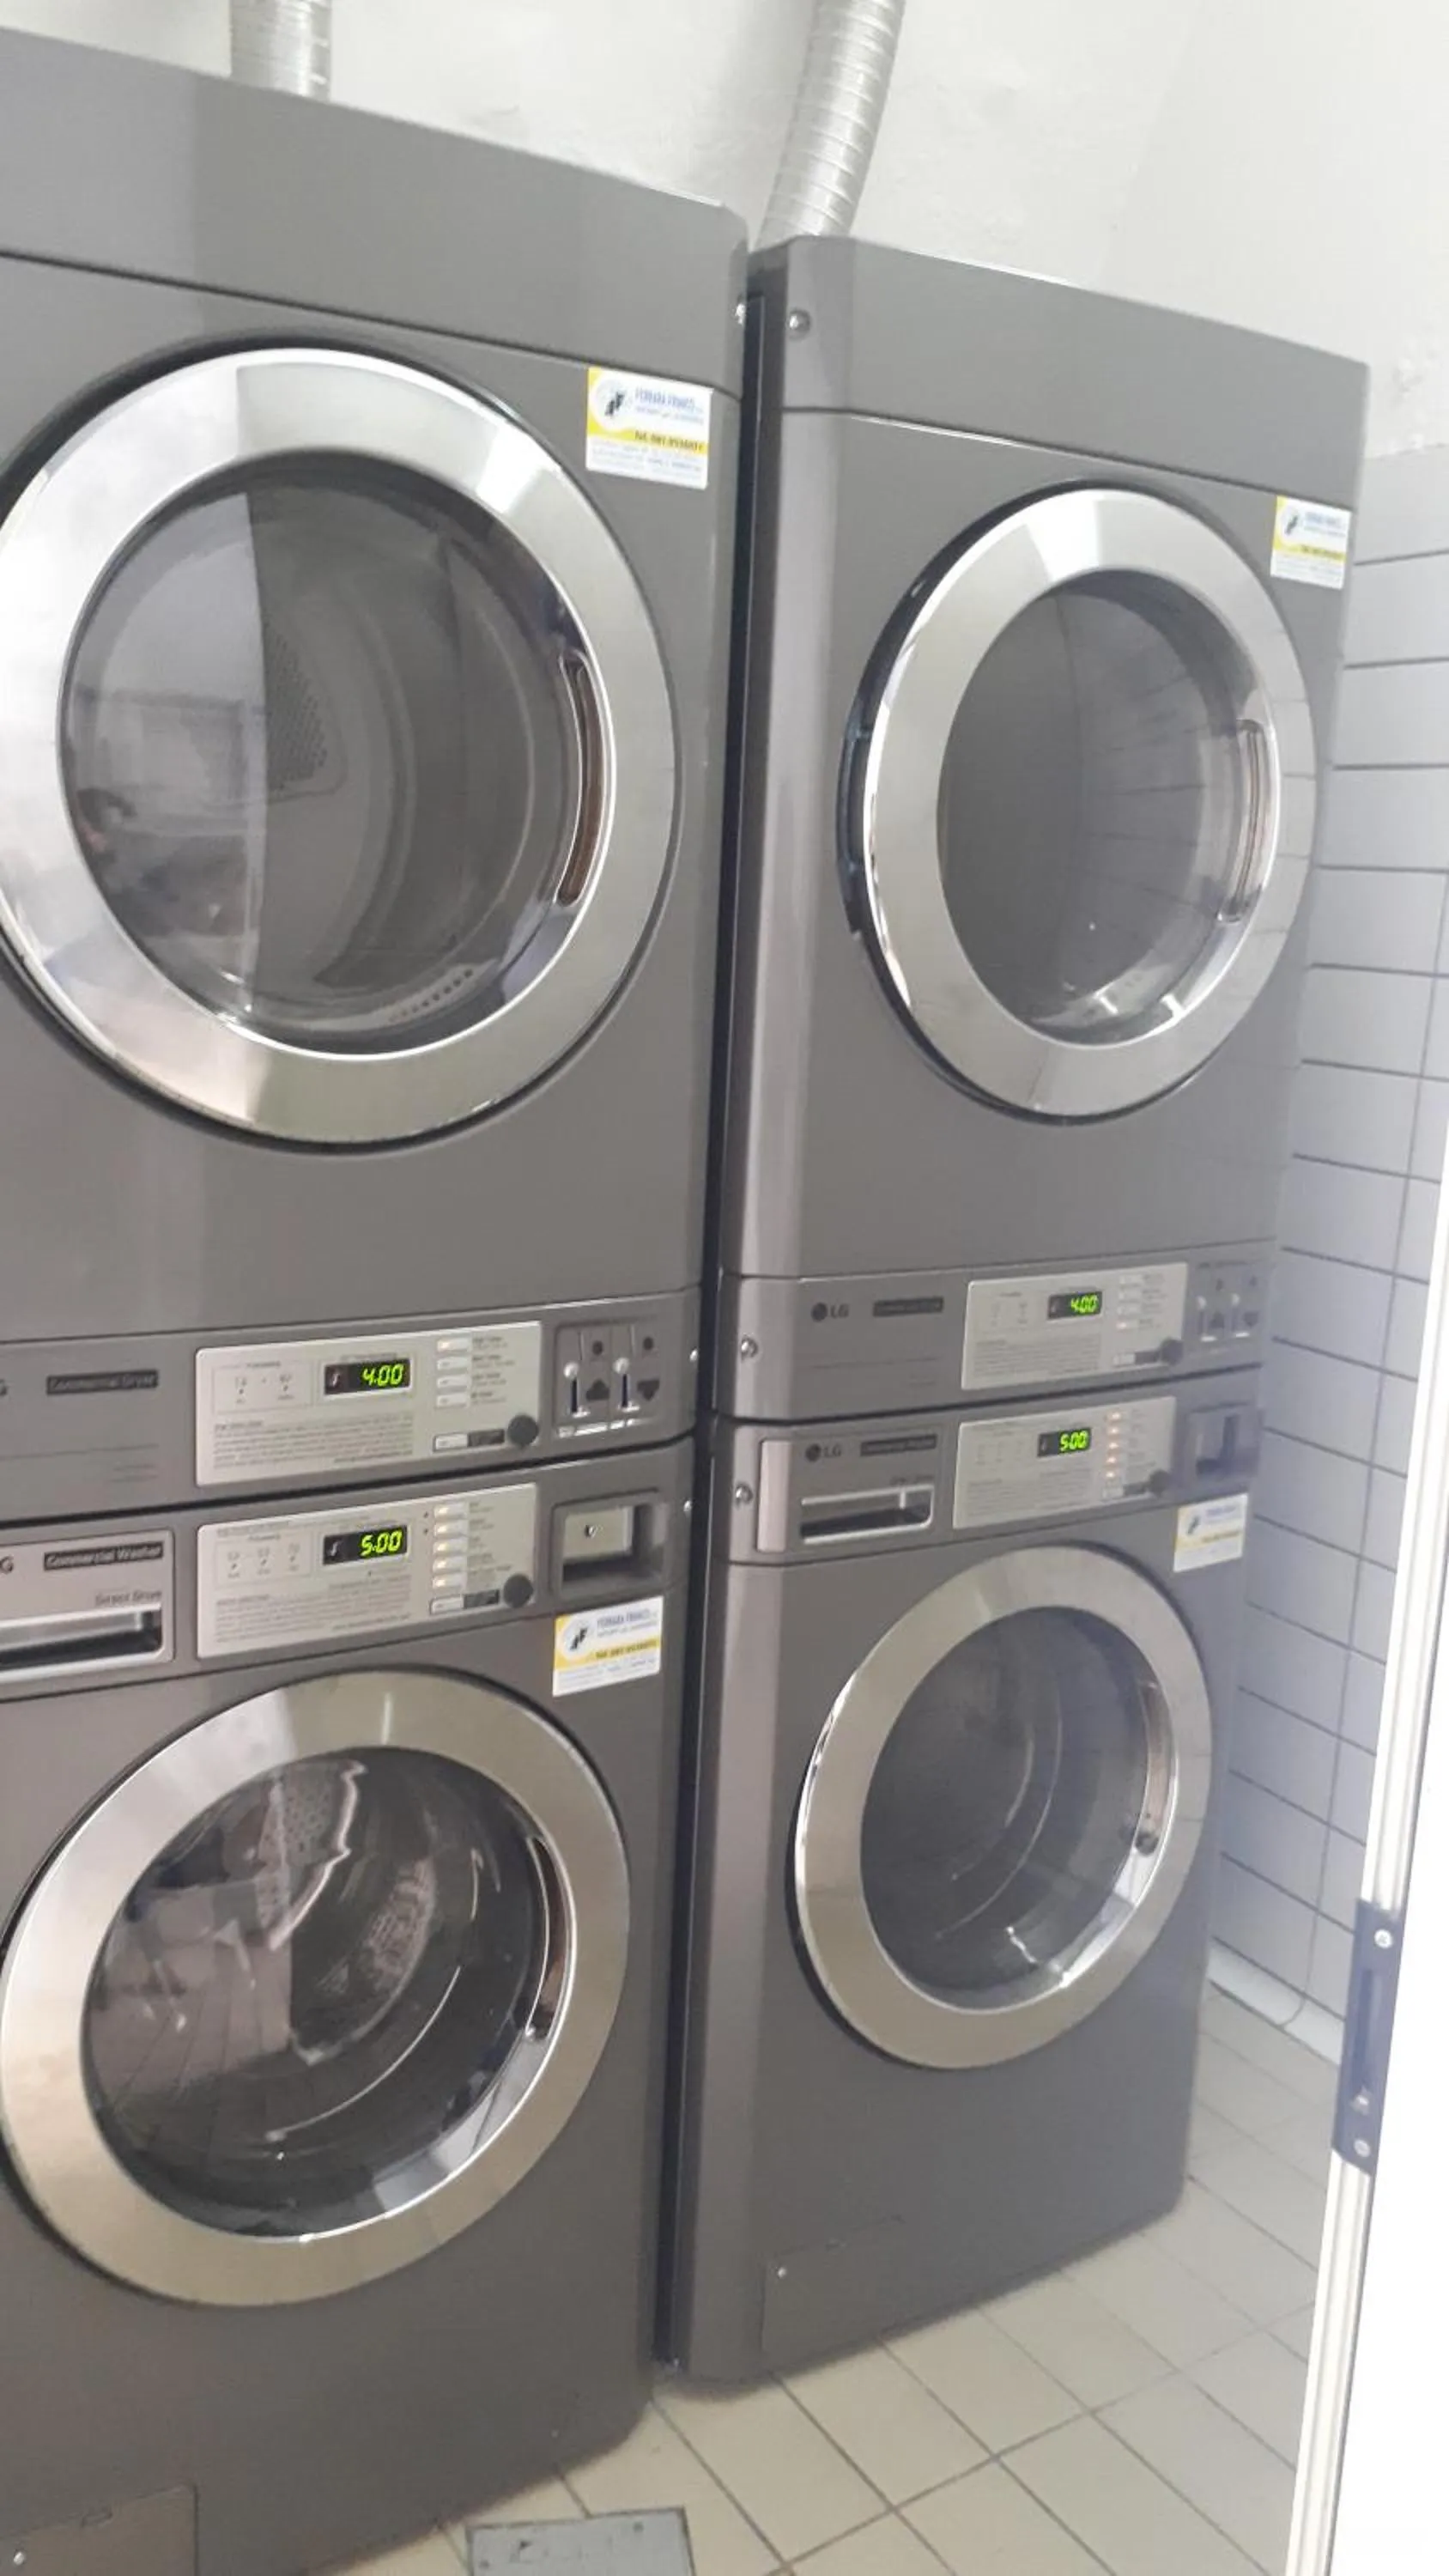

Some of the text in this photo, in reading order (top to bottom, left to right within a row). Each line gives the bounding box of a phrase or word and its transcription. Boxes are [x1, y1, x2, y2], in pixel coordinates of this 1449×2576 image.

[829, 1302, 849, 1319] LG
[361, 1363, 405, 1388] 4.00
[823, 1444, 842, 1458] LG
[360, 1529, 403, 1558] 5.00
[45, 1547, 115, 1569] Commercial
